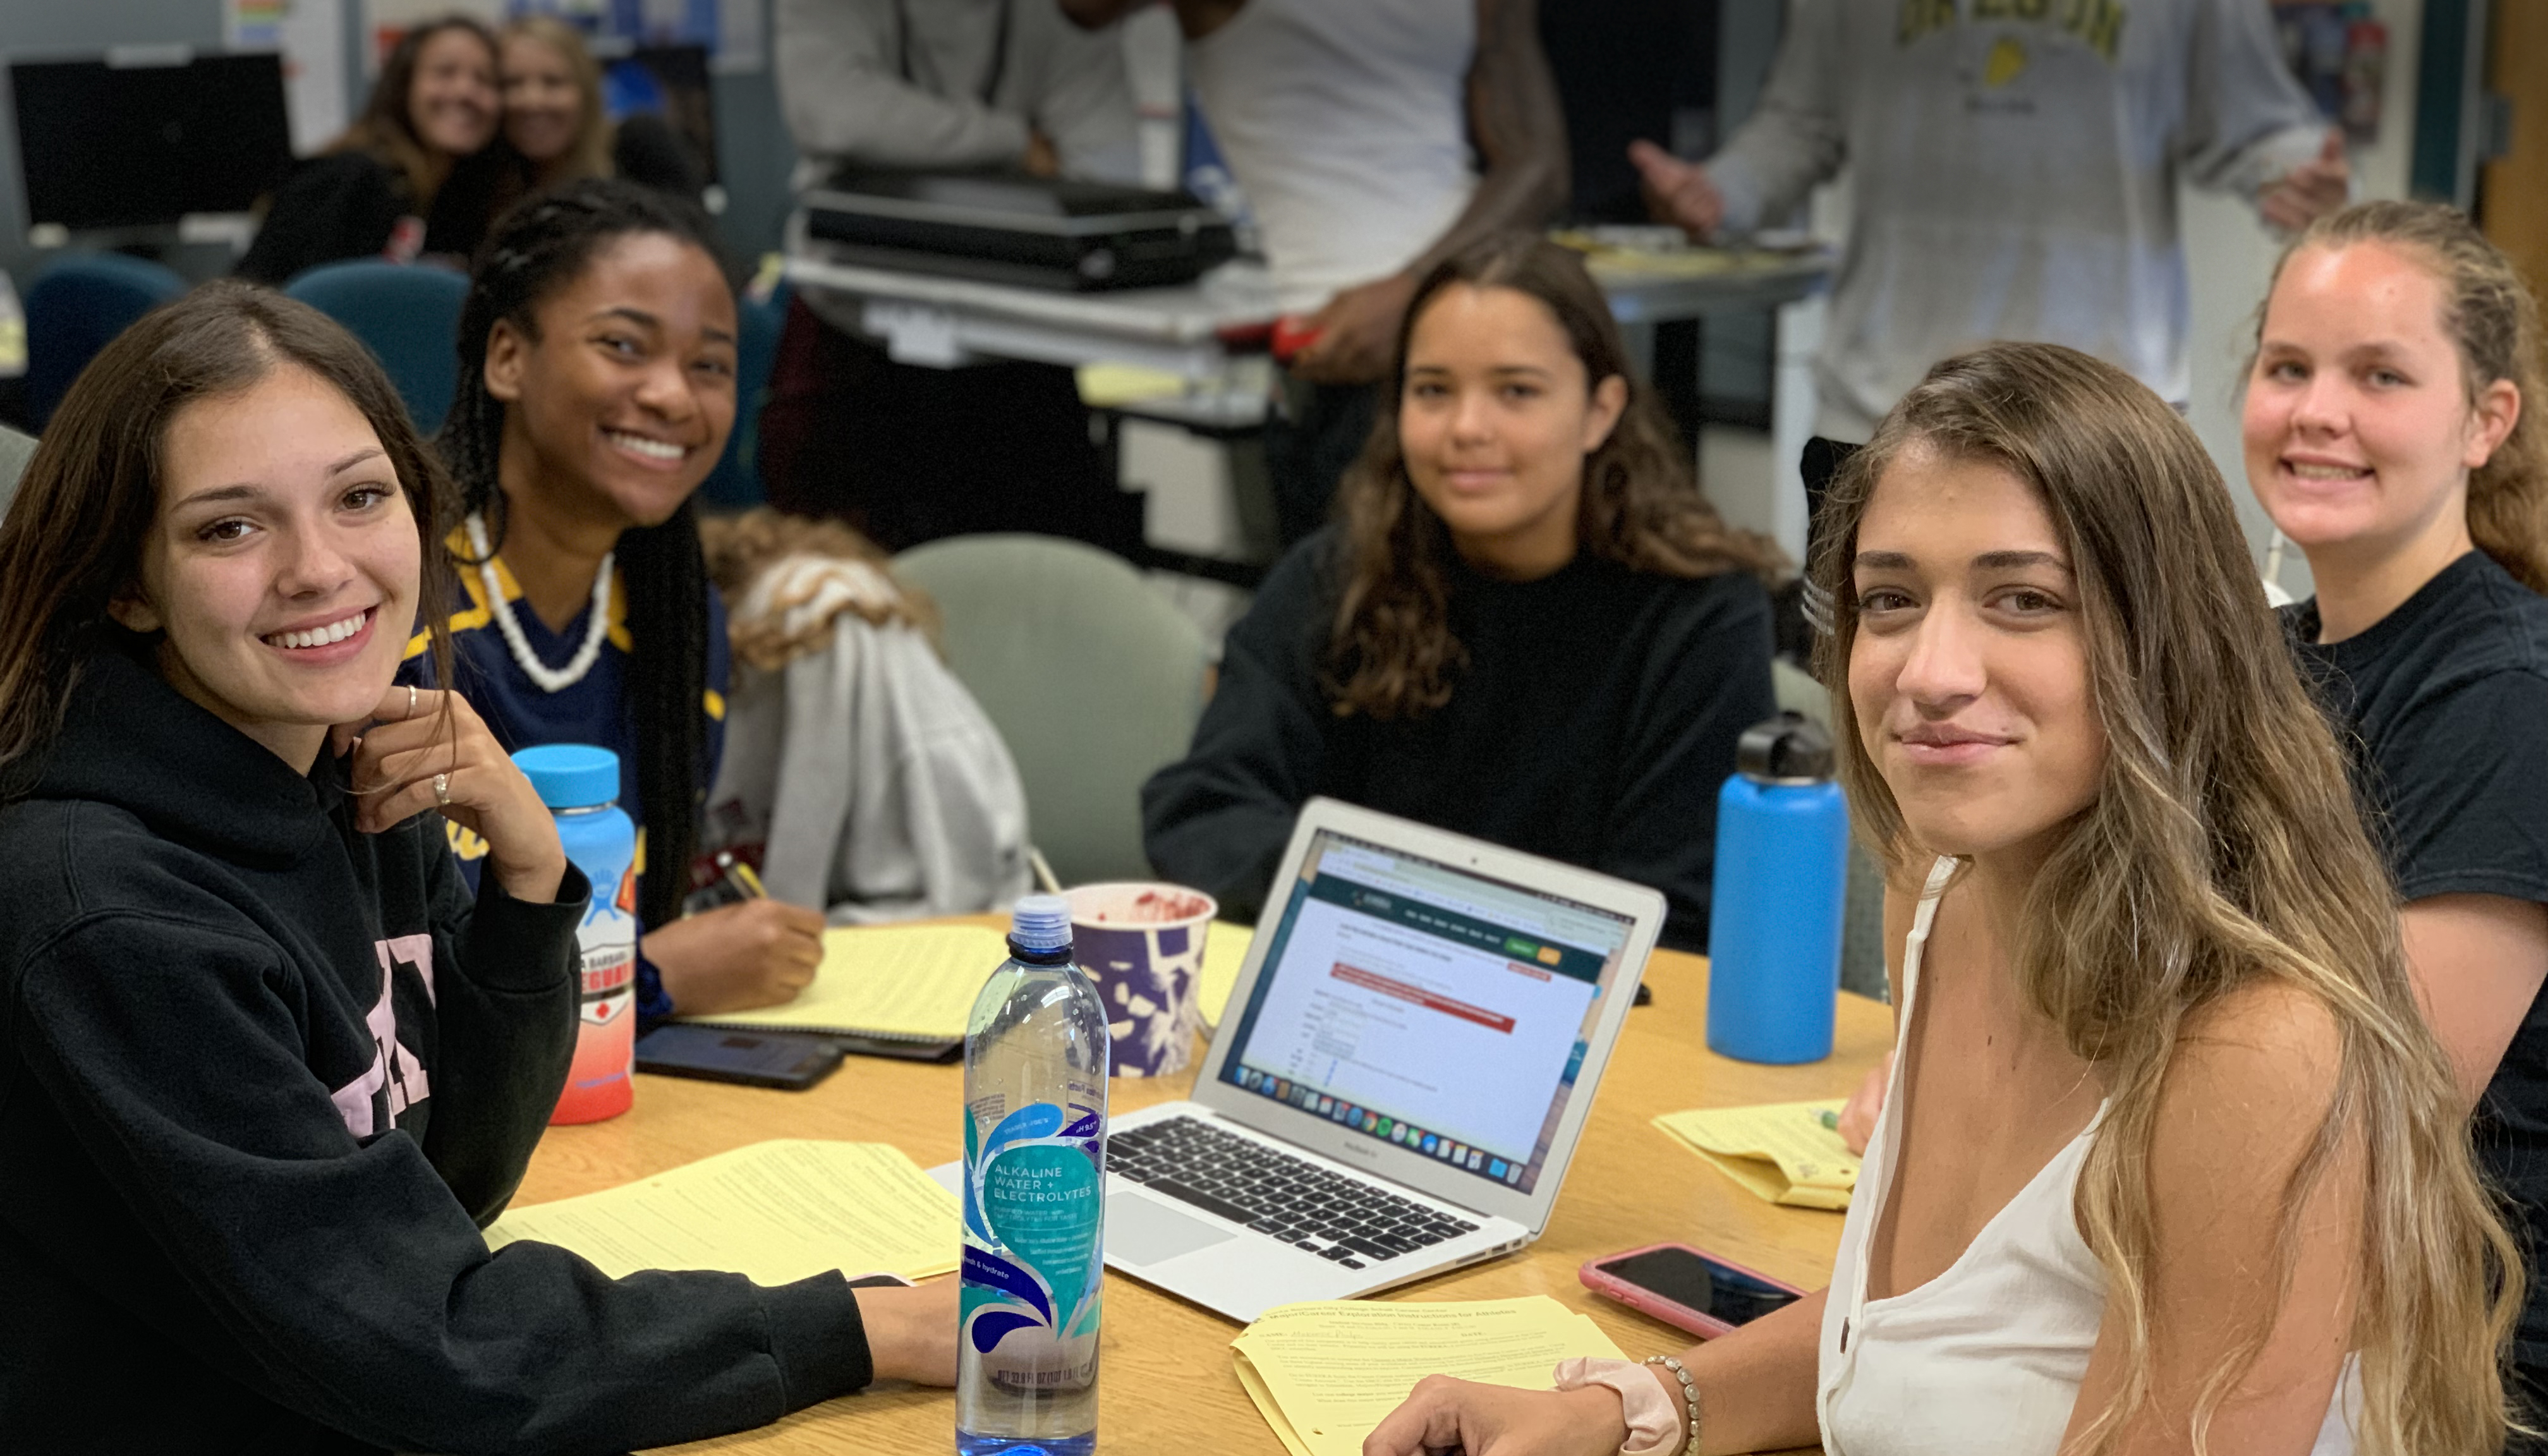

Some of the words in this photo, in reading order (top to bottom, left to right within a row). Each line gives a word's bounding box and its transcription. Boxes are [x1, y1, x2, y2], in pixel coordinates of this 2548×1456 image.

[995, 1164, 1062, 1179] ALKALINE
[994, 1176, 1041, 1190] WATER
[994, 1186, 1091, 1203] ELECTROLYTES
[982, 1263, 1009, 1280] hydrate
